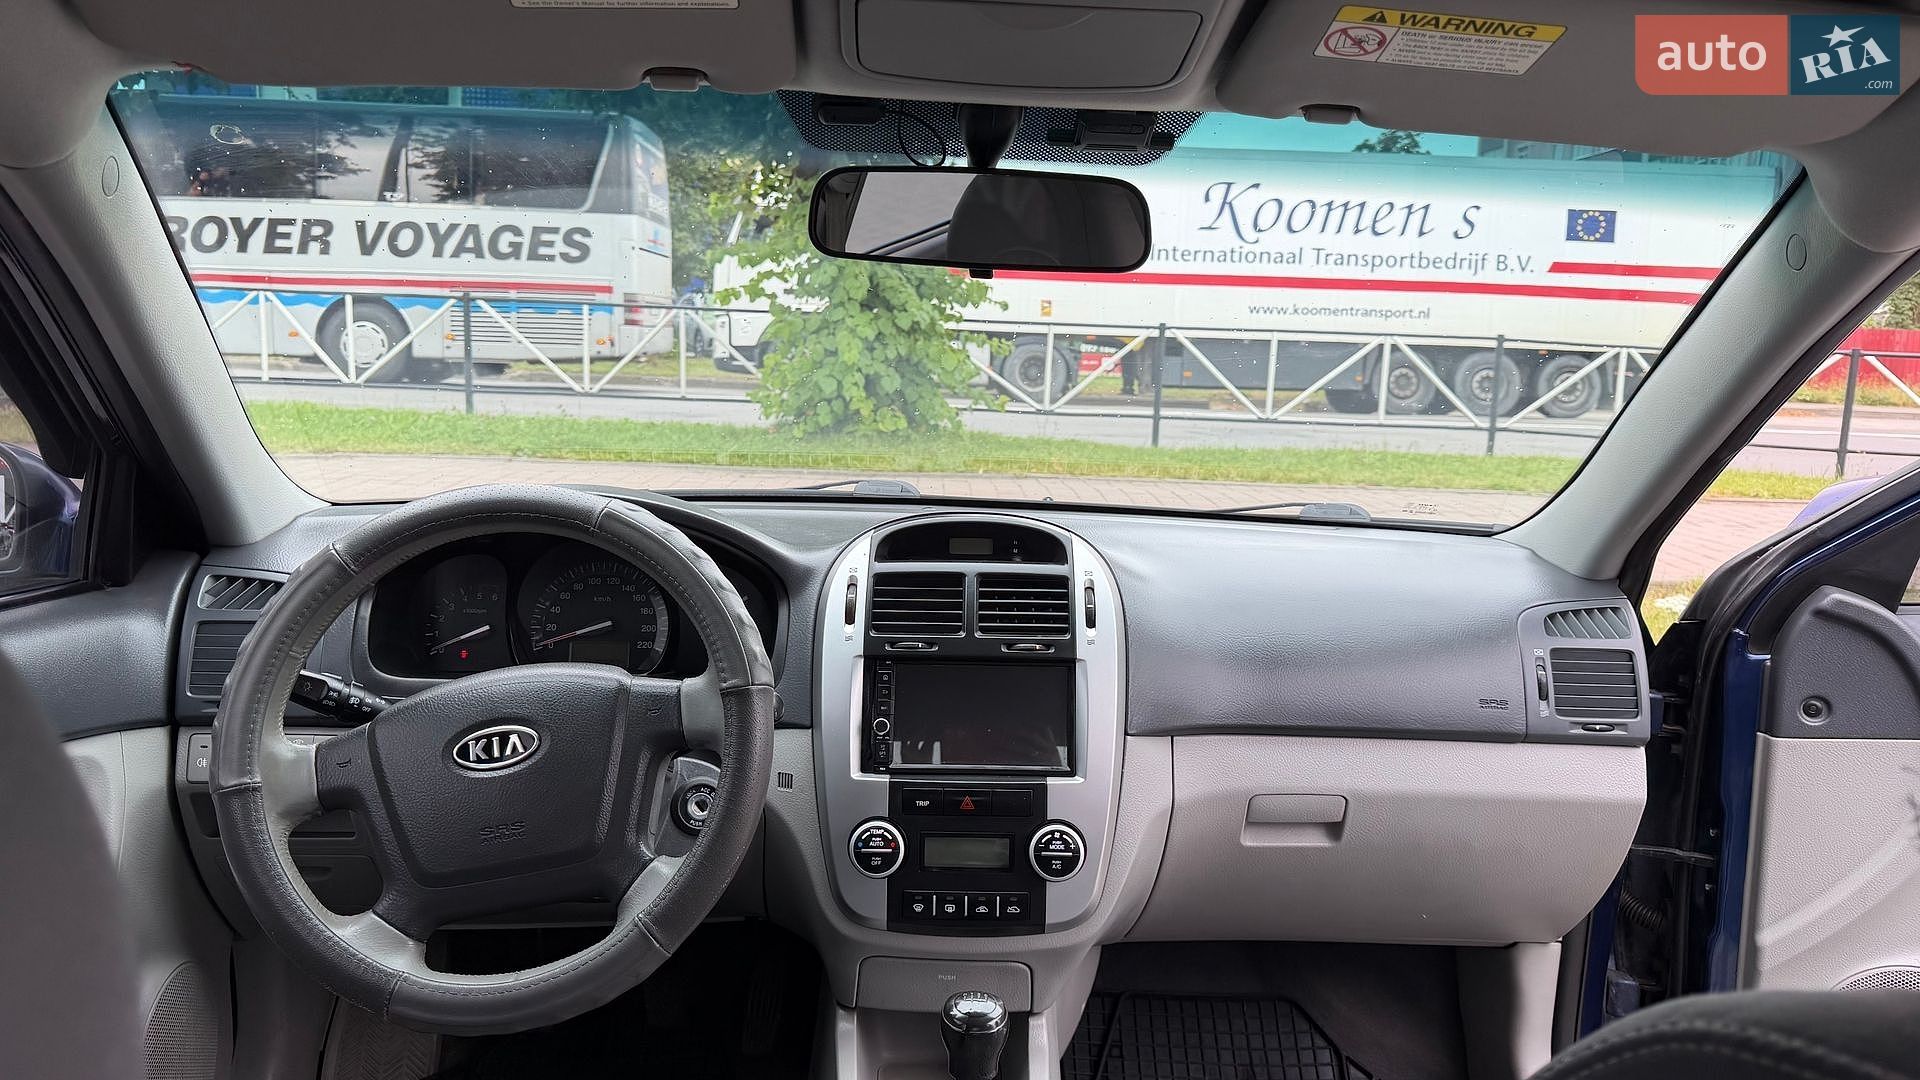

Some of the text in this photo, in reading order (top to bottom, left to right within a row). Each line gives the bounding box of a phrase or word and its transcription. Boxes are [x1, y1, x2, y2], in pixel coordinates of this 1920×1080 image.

[1399, 12, 1537, 38] WARNING
[1197, 181, 1482, 244] Koomen s
[355, 219, 593, 264] VOYAGES
[1151, 244, 1534, 276] Internationaal Transportbedrijf B.V.
[1248, 304, 1430, 321] www.koomentransport.nl
[545, 623, 557, 632] 20
[641, 624, 657, 633] 200
[636, 640, 653, 650] 220
[467, 733, 525, 761] KIA
